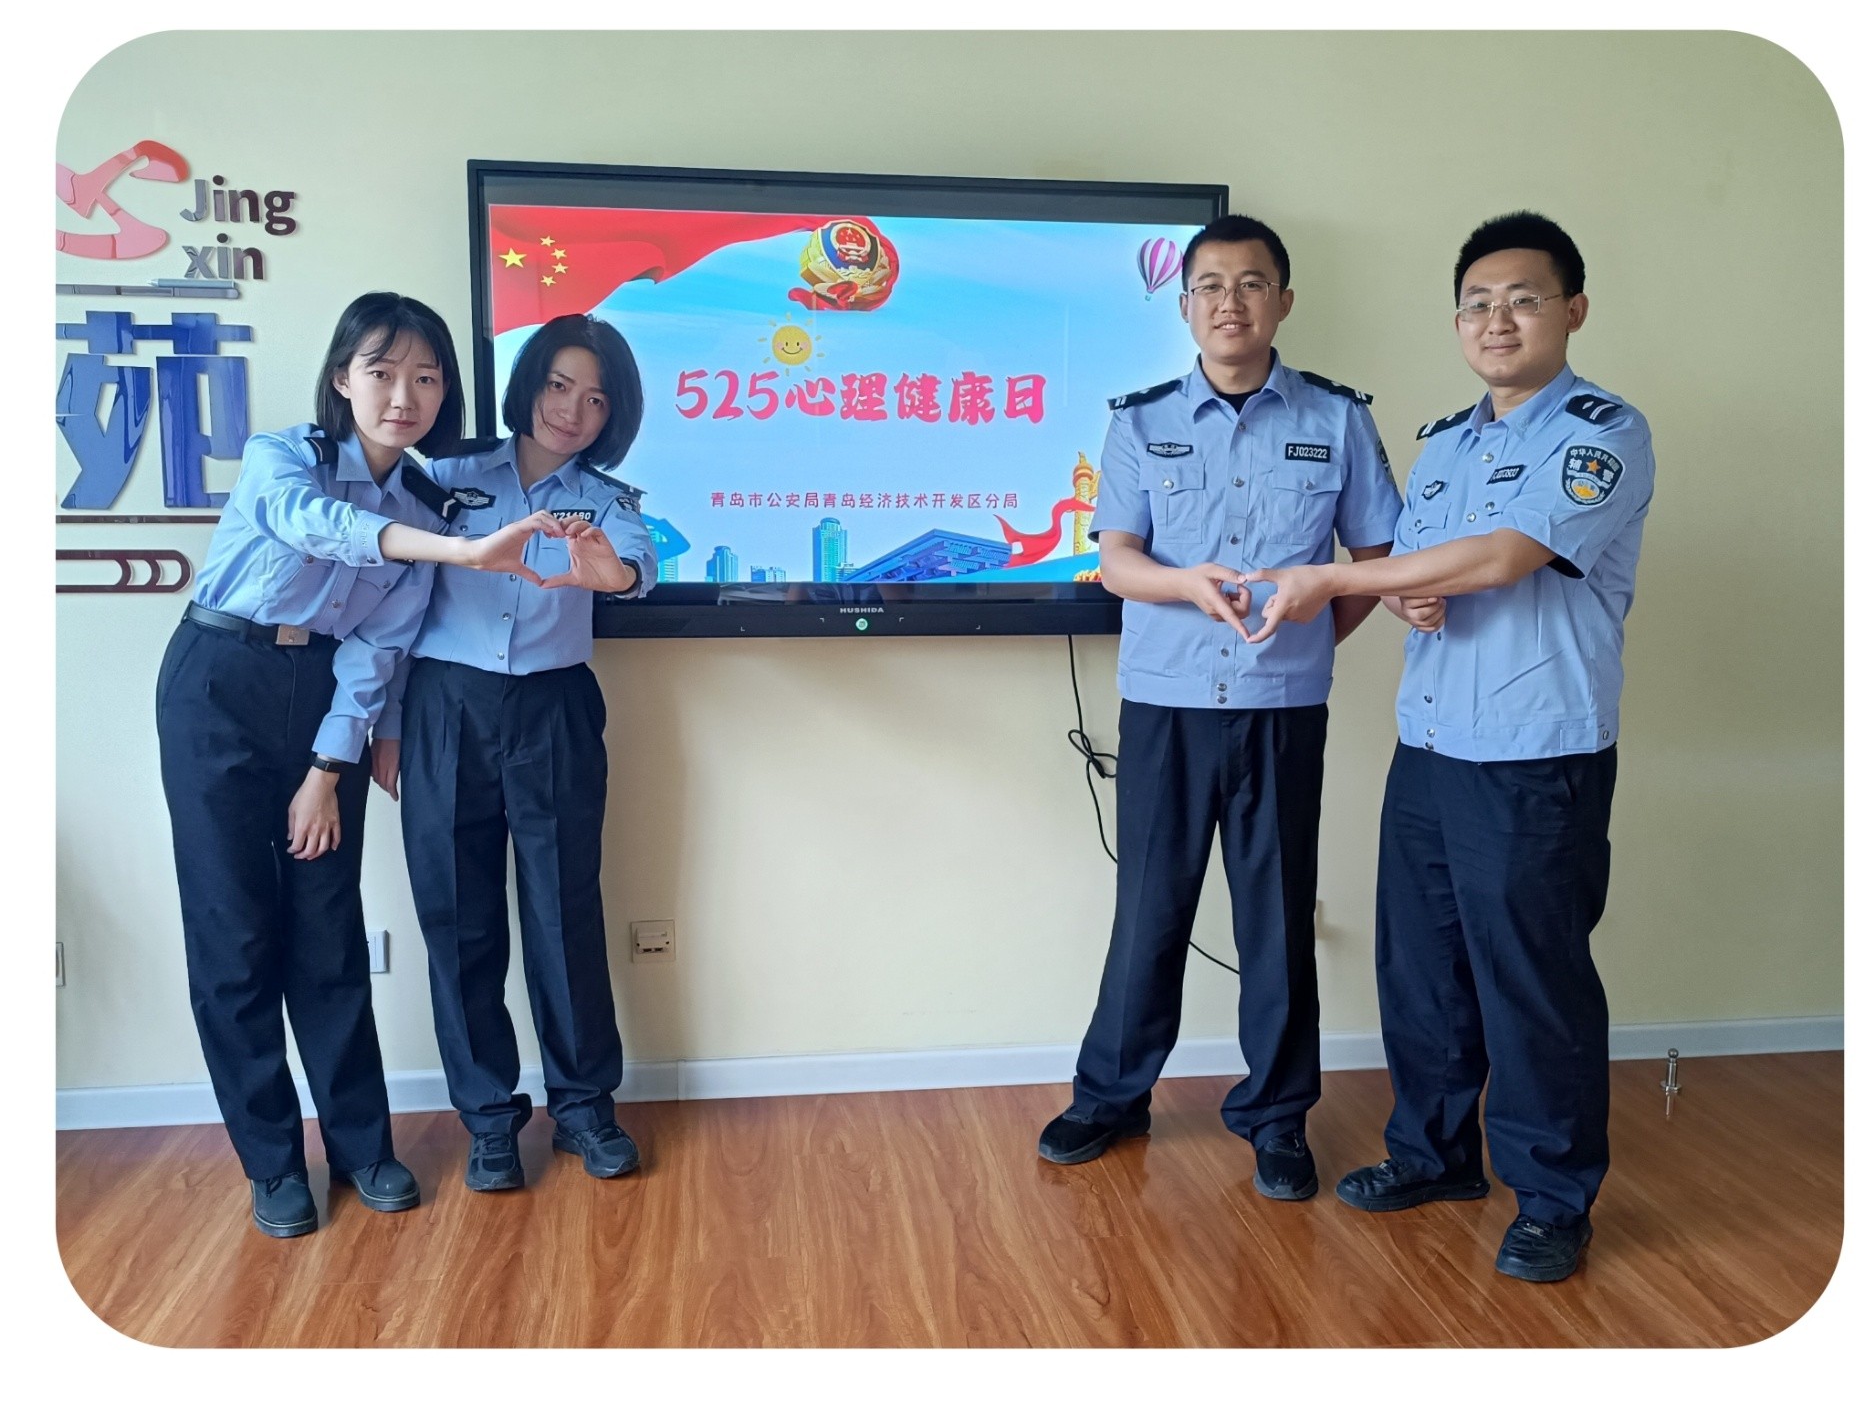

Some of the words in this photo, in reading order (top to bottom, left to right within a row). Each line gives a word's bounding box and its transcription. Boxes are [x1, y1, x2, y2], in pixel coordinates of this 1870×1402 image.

[180, 174, 298, 236] Jing
[182, 233, 265, 280] xin
[675, 367, 1048, 426] 525心理健康日
[1287, 445, 1328, 459] FJ023222
[710, 490, 1018, 511] 青岛市公安局青岛经济技术开发区分局
